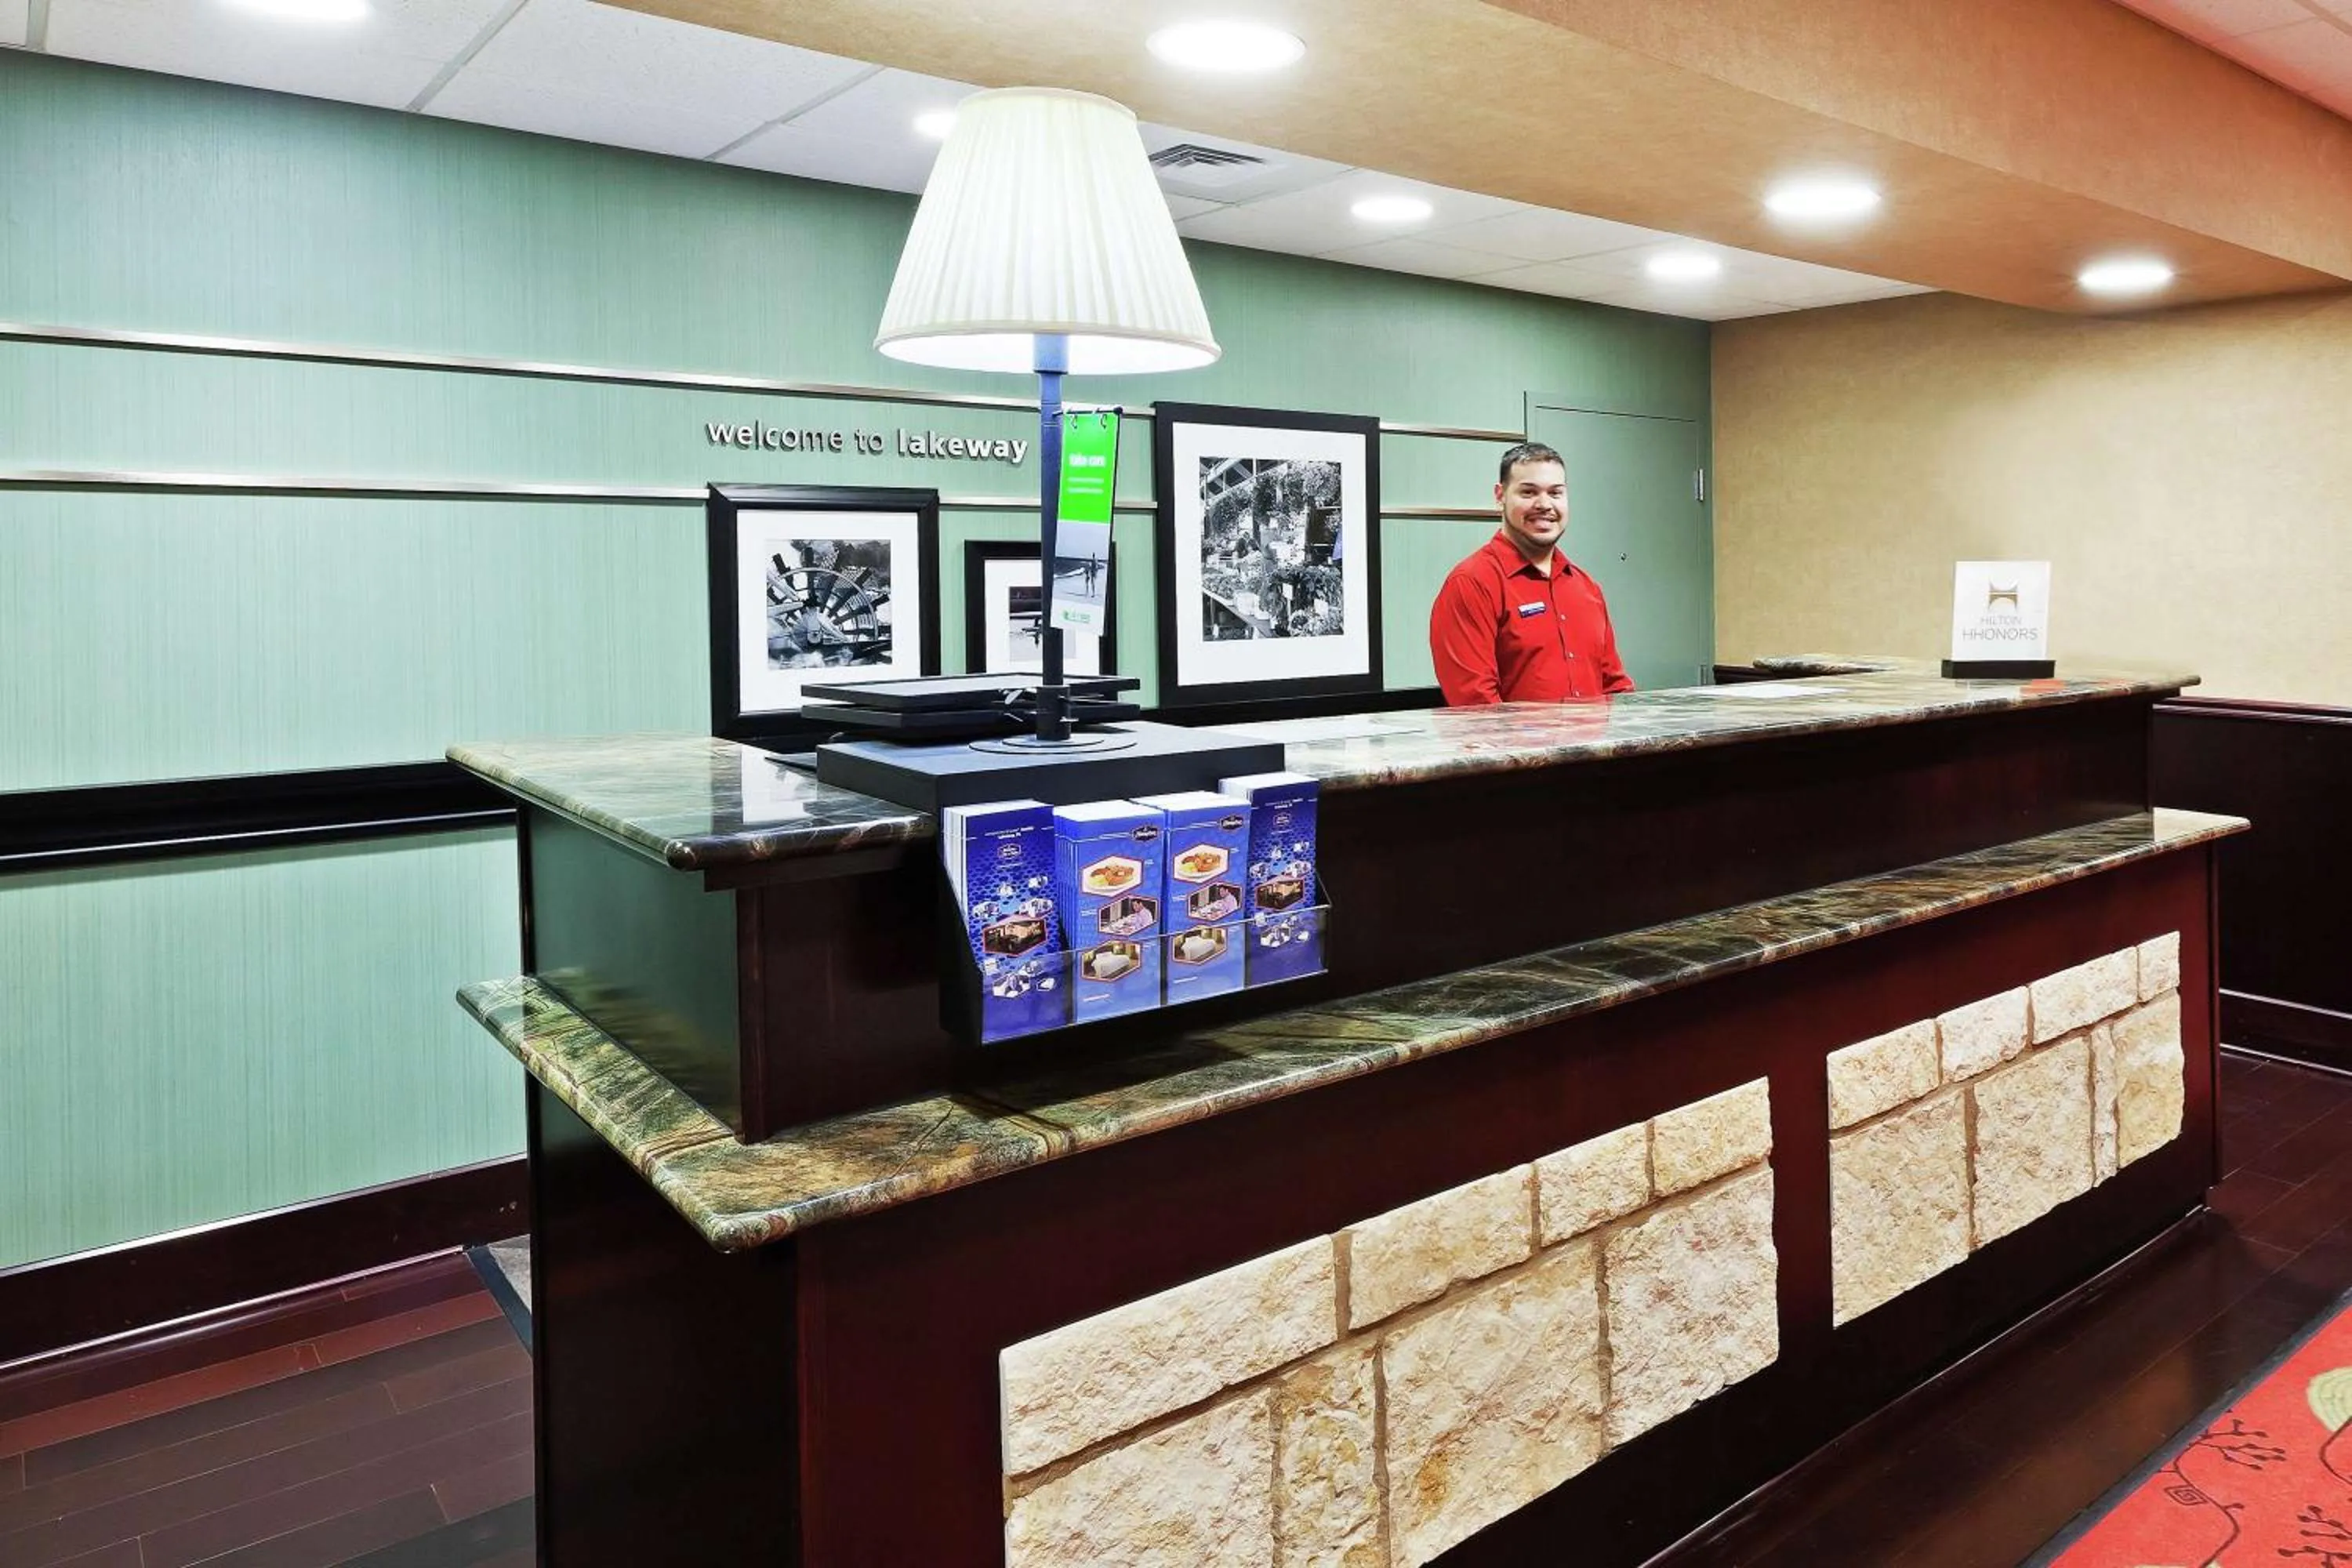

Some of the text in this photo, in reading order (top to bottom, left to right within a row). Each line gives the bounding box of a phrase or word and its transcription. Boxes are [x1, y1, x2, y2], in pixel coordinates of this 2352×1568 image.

[706, 420, 1029, 467] welcome to lakeway
[1980, 615, 2023, 626] HILTON
[1962, 627, 2038, 641] HHONORS
